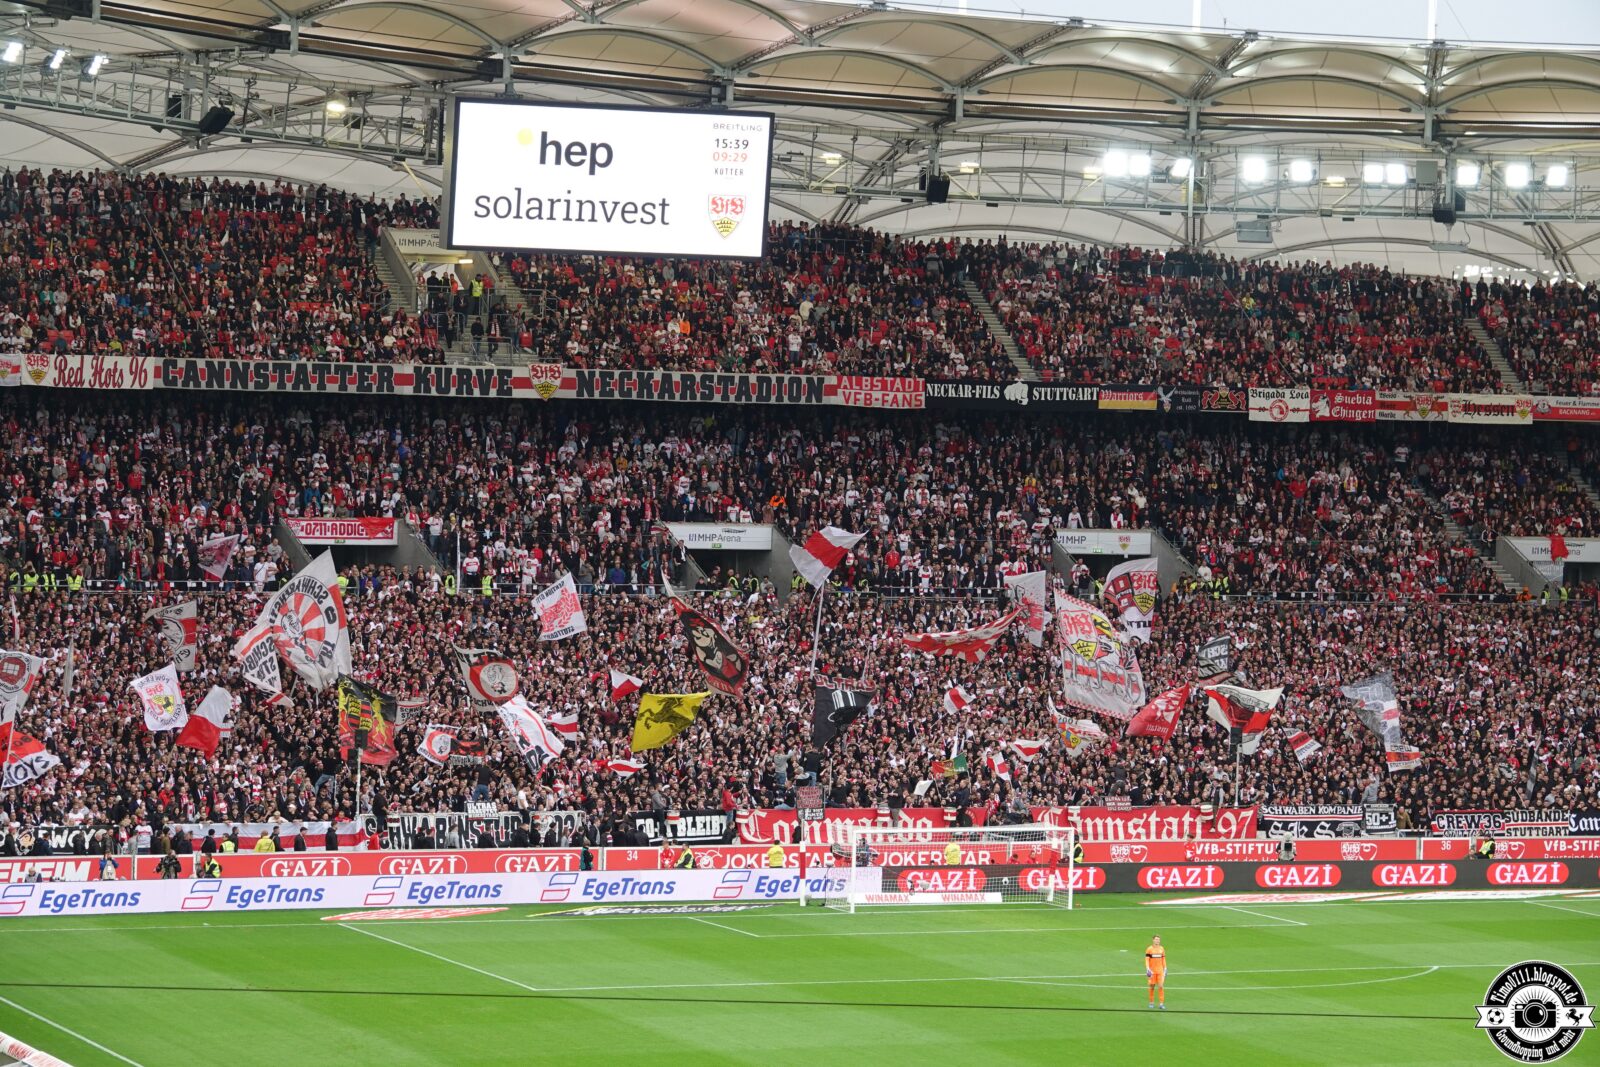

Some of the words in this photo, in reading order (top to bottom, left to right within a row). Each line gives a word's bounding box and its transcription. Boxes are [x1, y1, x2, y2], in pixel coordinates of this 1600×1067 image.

[713, 123, 763, 132] BREITLING
[714, 138, 750, 150] 15:39
[539, 131, 614, 175] hep
[712, 151, 748, 163] 09:29
[473, 187, 670, 226] solarinvest
[407, 239, 427, 247] MHP
[53, 355, 85, 387] Red
[89, 355, 125, 388] Hots
[129, 357, 148, 388] 96
[162, 358, 395, 393] CANNSTATTER
[413, 365, 513, 397] KURVE
[575, 370, 825, 404] NECKARSTADION
[840, 377, 925, 393] ALBSTADT
[926, 382, 1001, 400] NECKAR-FILS
[1032, 386, 1100, 401] STUTTGART
[842, 389, 924, 408] VFB-FANS
[1101, 389, 1144, 402] Warriors
[1250, 388, 1285, 400] Brigada
[1289, 388, 1309, 399] Loca
[1334, 392, 1372, 405] Suebia
[1331, 406, 1376, 420] Ehingen
[305, 522, 327, 536] 0711
[331, 522, 368, 536] ADDIC
[697, 533, 717, 542] MHP
[717, 533, 742, 543] Arena
[1065, 535, 1087, 544] MHP
[1262, 805, 1316, 815] SCHWABEN
[1318, 804, 1363, 814] KOMPANIE
[1217, 810, 1254, 840] 97
[1365, 811, 1396, 825] 50+1
[1436, 813, 1482, 830] CREW
[1483, 813, 1502, 829] 36
[676, 815, 728, 837] BLEIBT
[1505, 826, 1569, 837] STUTTGART
[1031, 845, 1042, 855] 35
[1195, 843, 1296, 855] VfB-STIFTU
[1441, 841, 1452, 851] 36
[626, 850, 639, 861] 34
[880, 850, 991, 867] JOKERTAR
[407, 881, 502, 904] EgeTrans
[582, 877, 676, 901] EgeTrans
[39, 889, 141, 913] EgeTrans
[226, 884, 325, 909] EgeTrans
